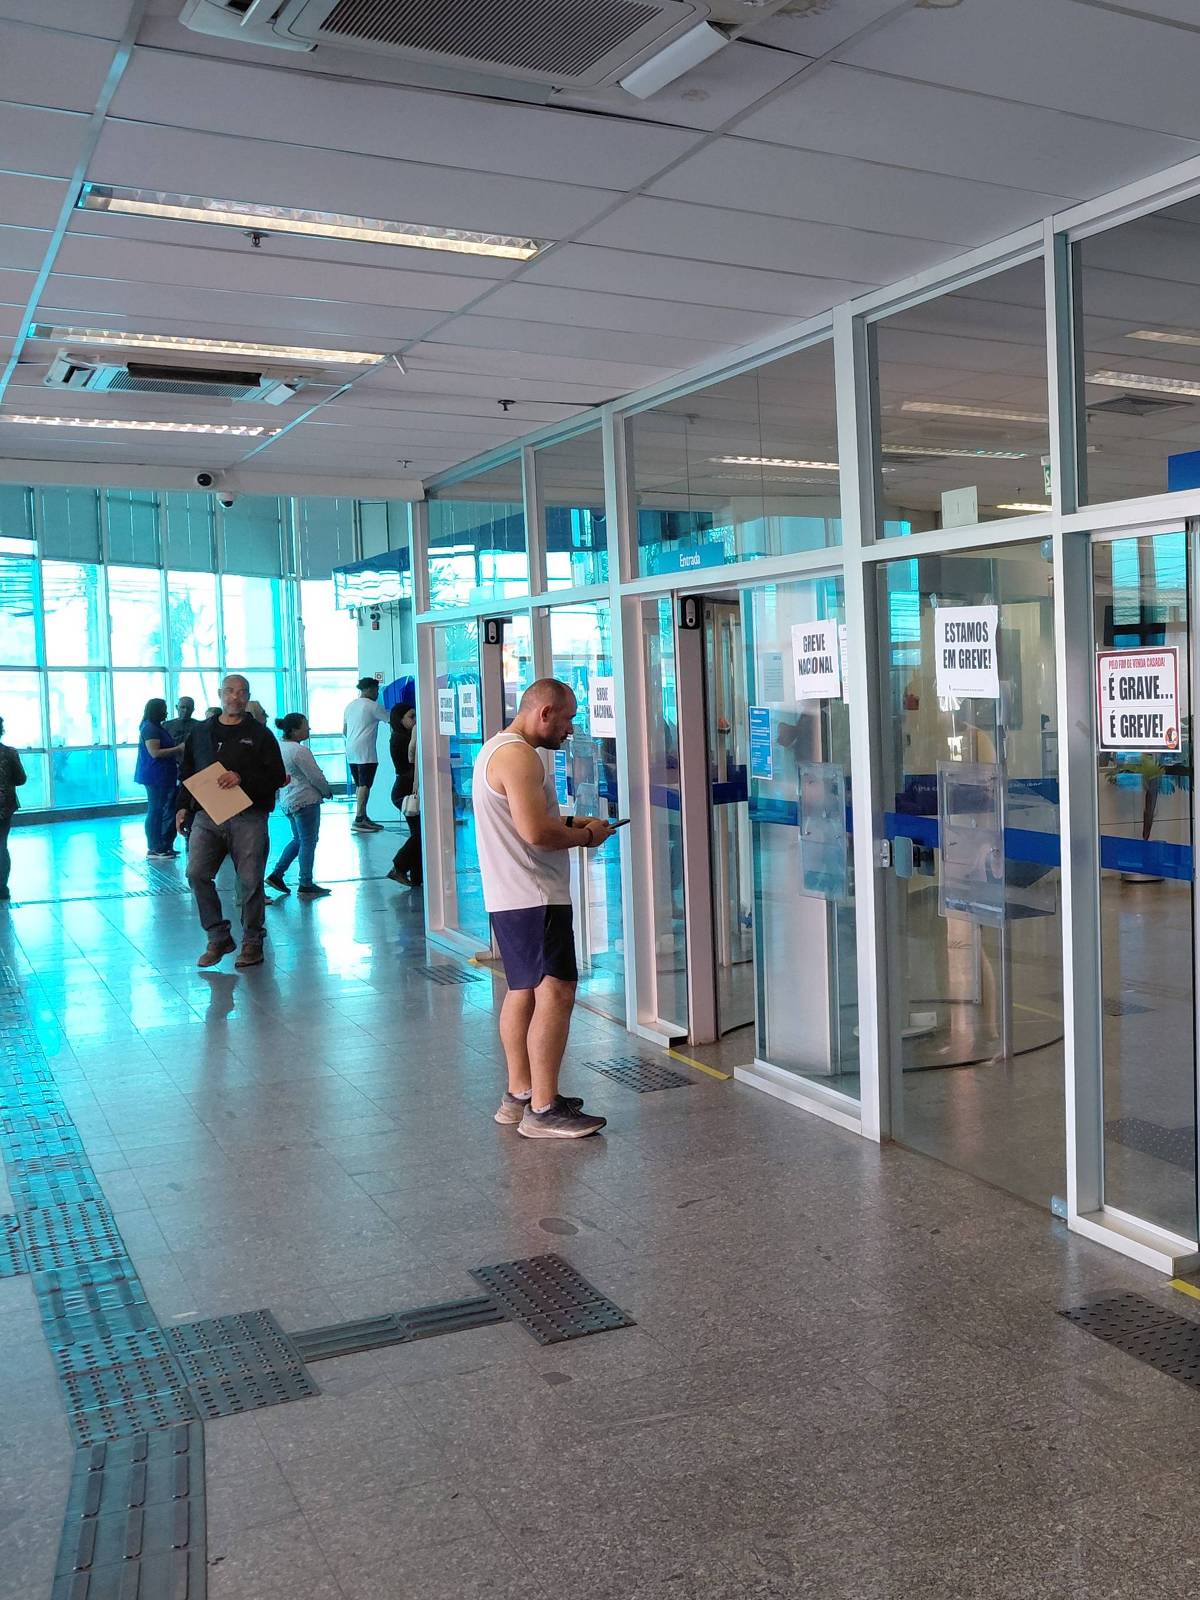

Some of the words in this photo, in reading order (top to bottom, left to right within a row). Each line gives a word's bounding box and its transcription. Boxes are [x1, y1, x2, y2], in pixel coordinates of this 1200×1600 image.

[679, 551, 701, 568] Entrada
[944, 621, 989, 643] ESTAMOS
[803, 633, 826, 653] GREVE
[798, 656, 834, 676] NACIONAL
[943, 648, 956, 669] EM
[958, 648, 992, 669] GREVE!
[1109, 673, 1116, 701] É
[1119, 676, 1174, 701] GRAVE...
[1109, 710, 1117, 738] É
[1120, 714, 1164, 738] GREVE!
